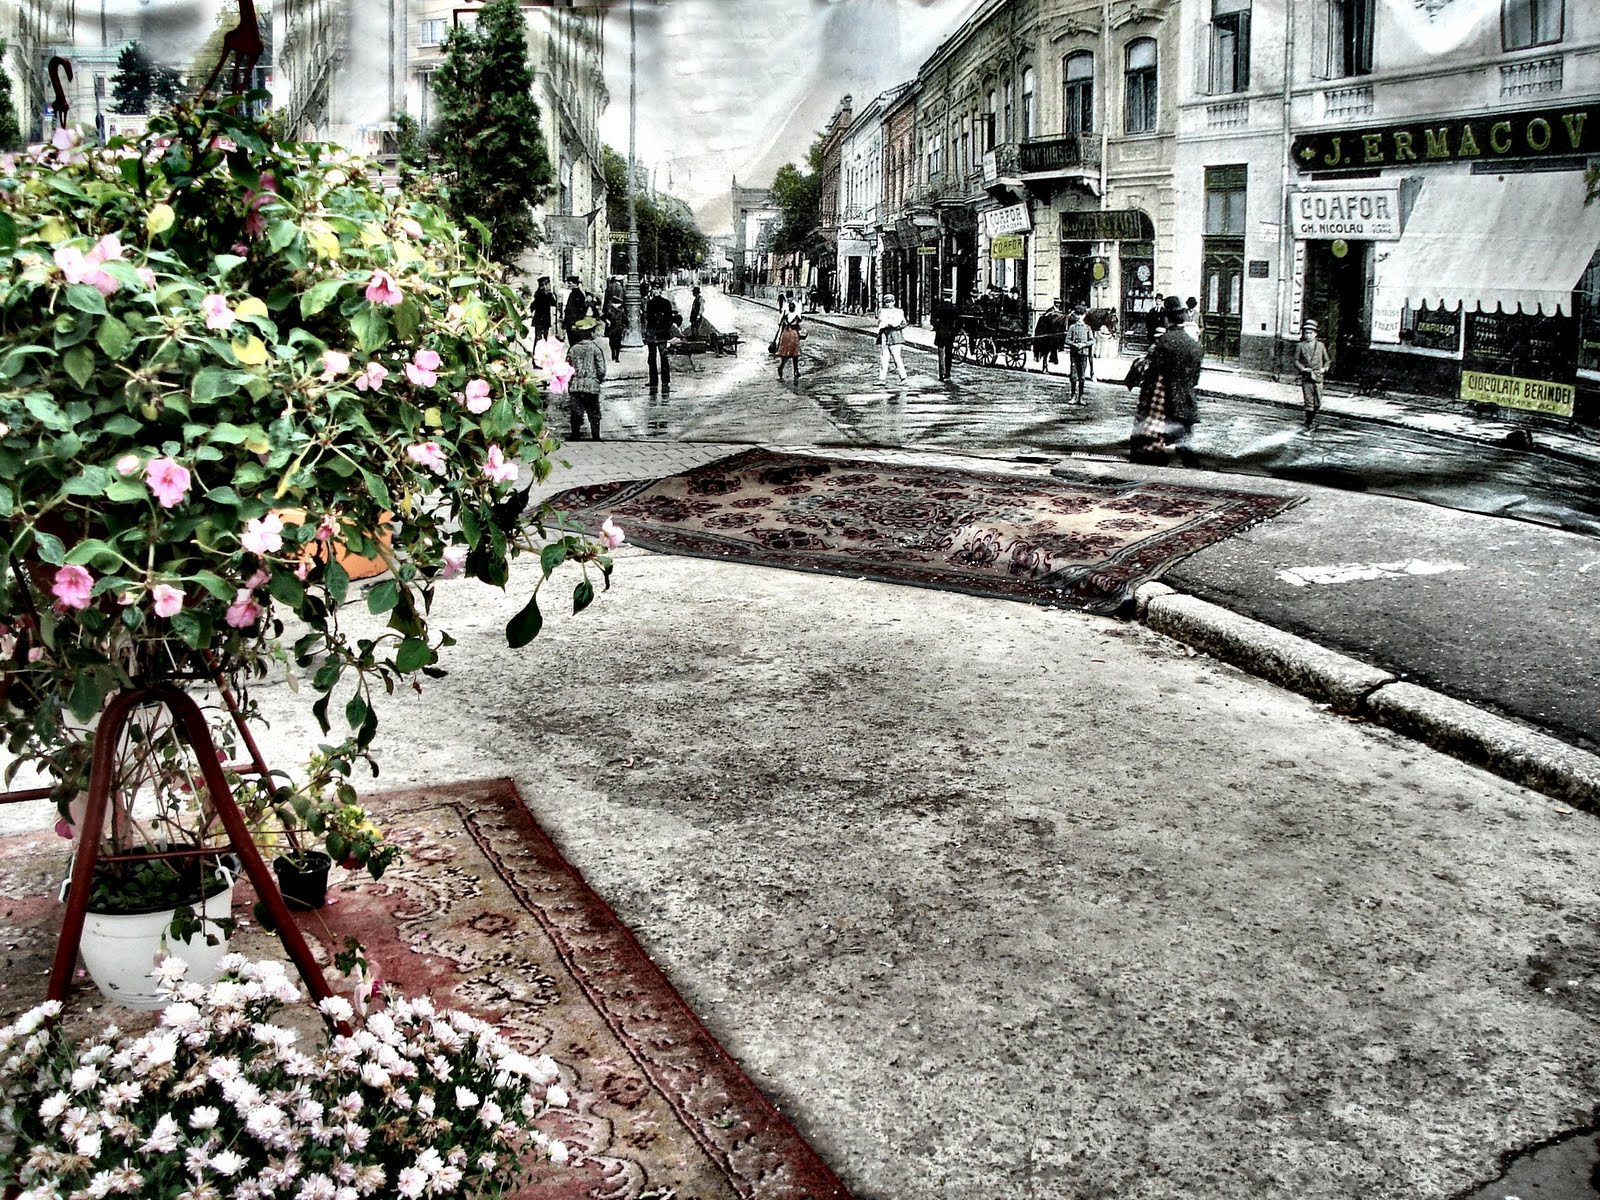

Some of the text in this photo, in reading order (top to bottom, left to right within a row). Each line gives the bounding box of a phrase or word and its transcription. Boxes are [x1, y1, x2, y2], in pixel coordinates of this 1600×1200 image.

[1324, 112, 1588, 166] J. ERMACOV
[1301, 195, 1391, 220] COAFOR
[1301, 223, 1317, 233] GH.
[1319, 223, 1364, 234] NICOLAU
[993, 239, 1022, 254] COAFOR
[1468, 375, 1571, 405] CIOCOLATA BERINDEI
